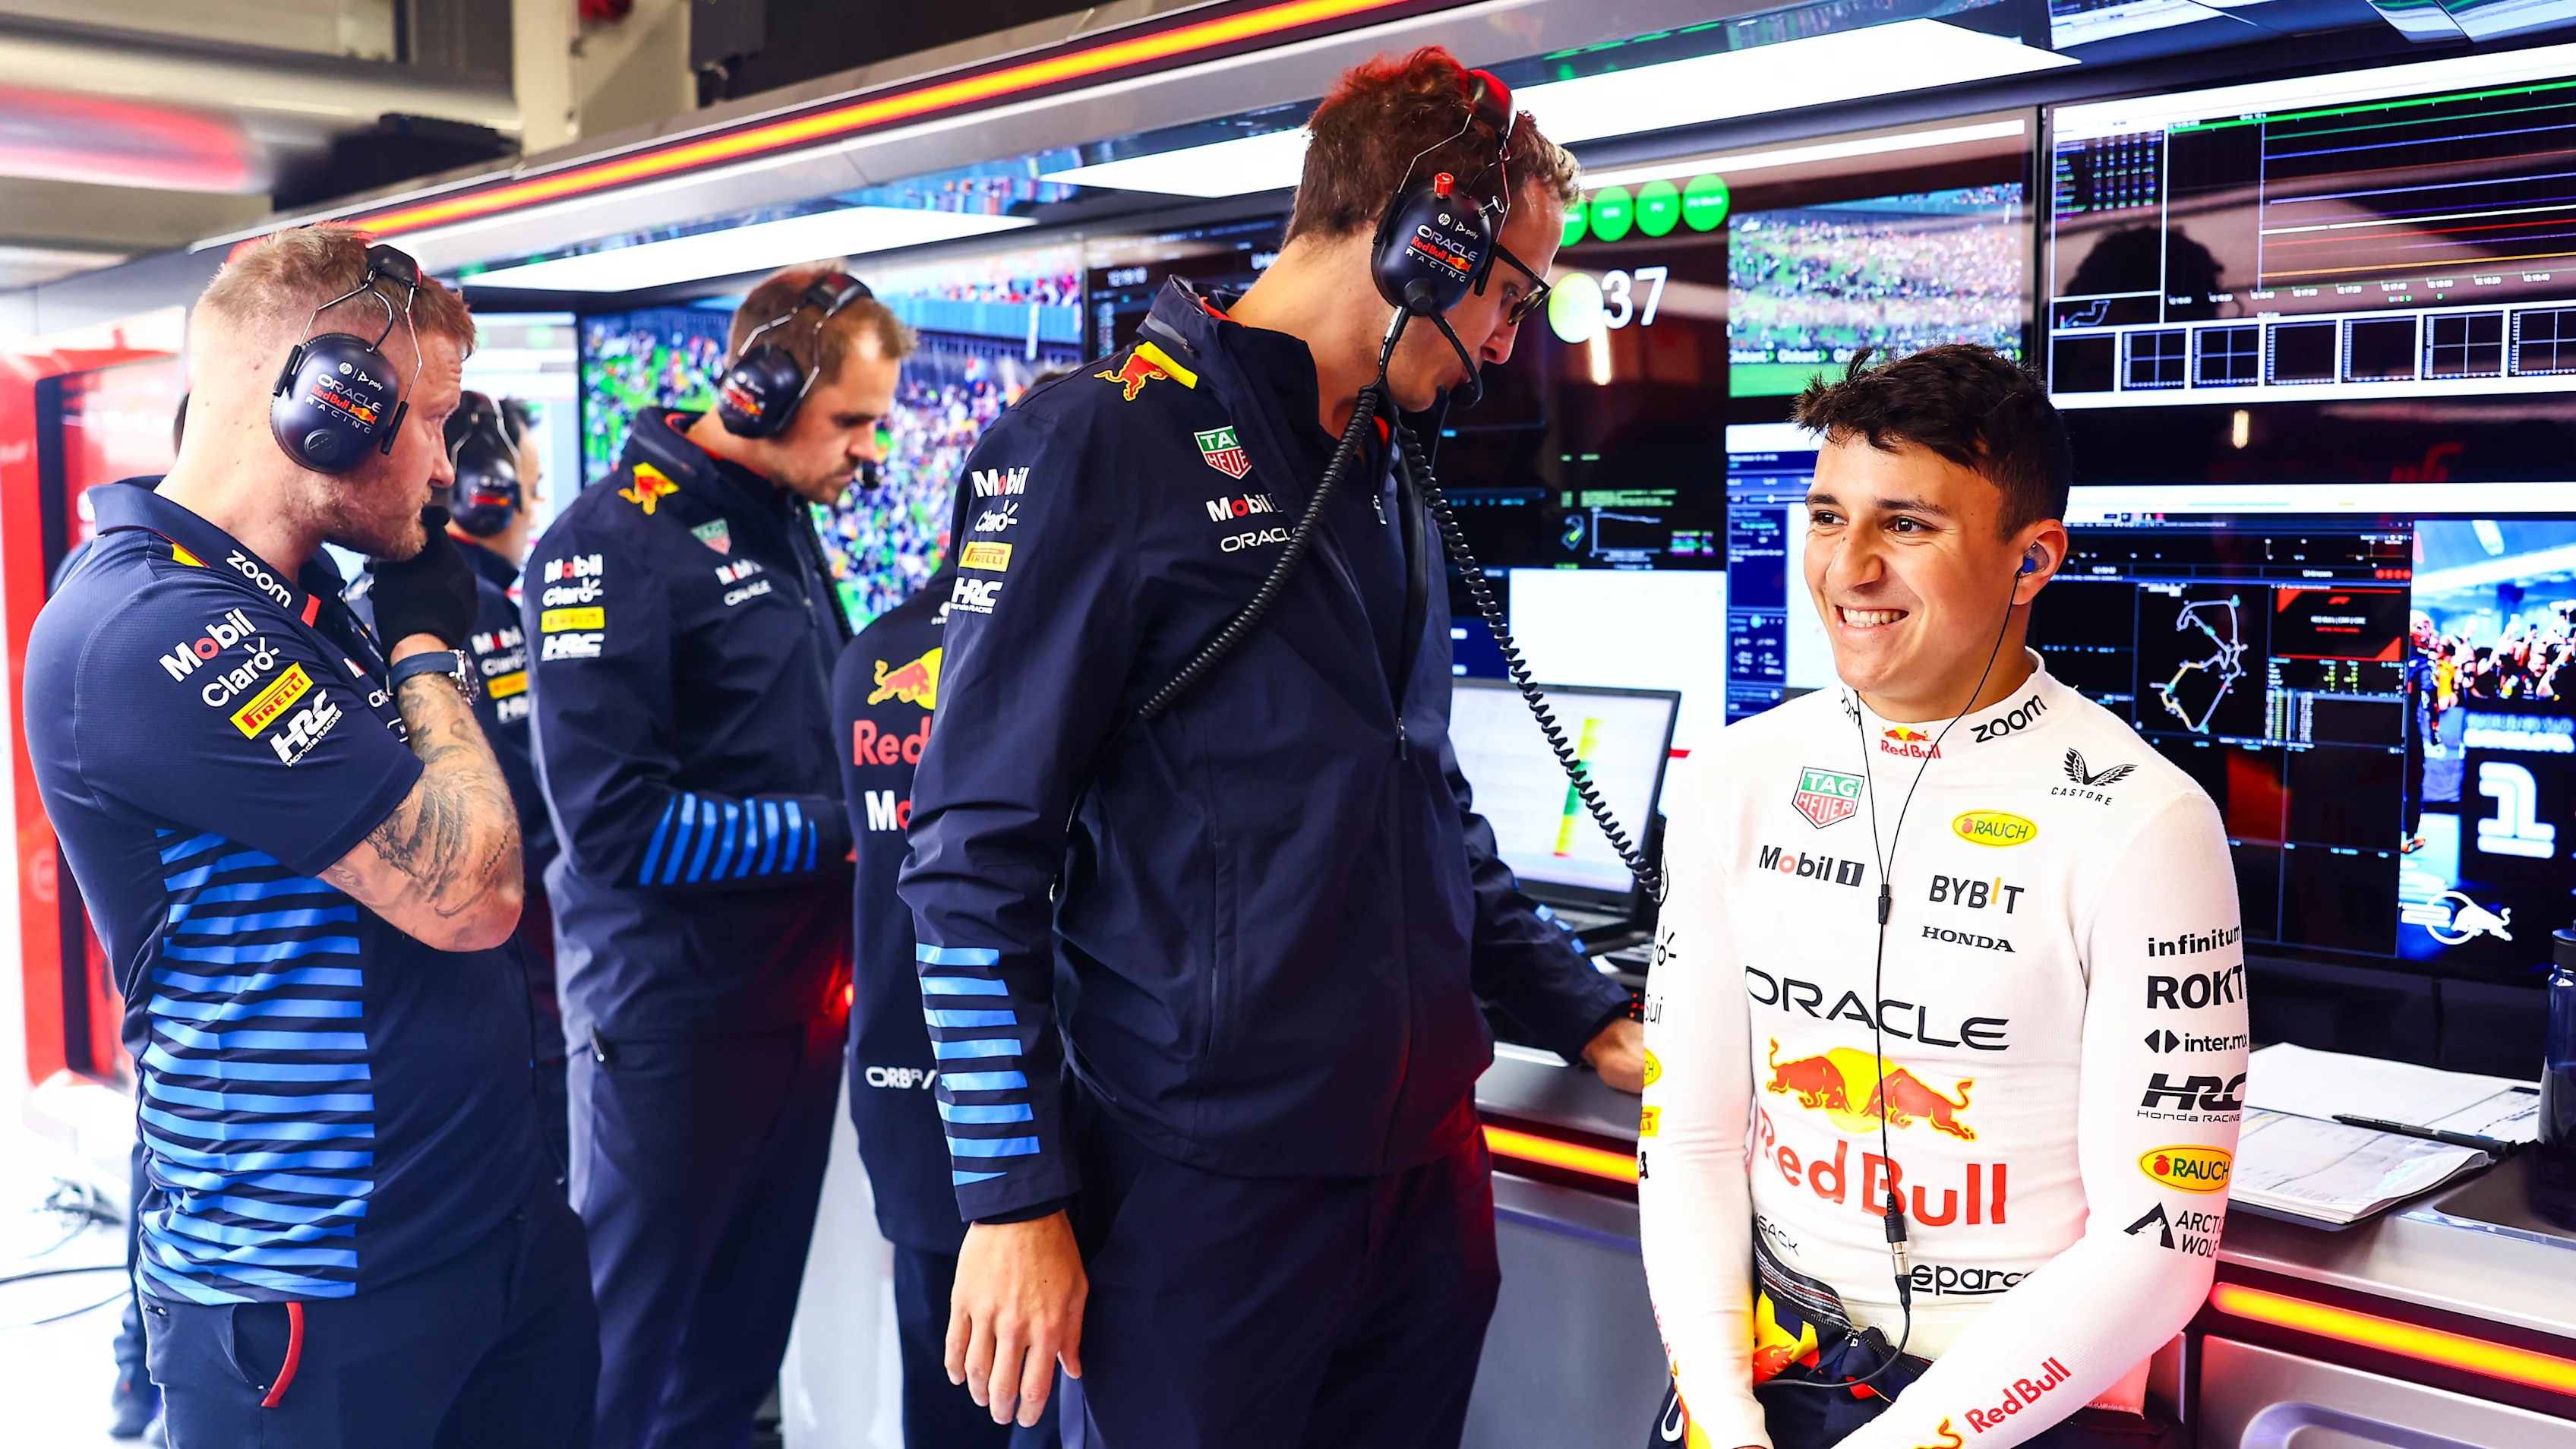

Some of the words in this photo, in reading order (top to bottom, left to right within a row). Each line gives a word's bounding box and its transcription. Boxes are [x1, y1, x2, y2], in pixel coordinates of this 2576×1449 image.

[1411, 235, 1429, 251] Red
[1428, 245, 1447, 260] Bull
[1417, 225, 1479, 262] ORACLE
[1465, 229, 1479, 240] poly
[1406, 248, 1466, 283] RACING
[1601, 266, 1668, 330] 37
[311, 384, 333, 402] Red
[329, 393, 351, 410] Bull
[317, 373, 383, 414] ORACLE
[368, 379, 384, 391] poly
[305, 396, 371, 434] RACING
[1200, 431, 1240, 451] TA
[1206, 450, 1249, 474] HEUE
[971, 466, 1031, 498] Mobil
[974, 503, 1015, 532] Claro
[1205, 494, 1274, 522] Mobil
[1220, 527, 1296, 553] ORACL
[544, 554, 603, 584] Mobil
[966, 547, 1005, 566] PIRELLI
[226, 549, 293, 608] zoom
[542, 579, 601, 608] Claro
[951, 576, 1004, 608] HRC
[158, 608, 257, 683] Mobil
[201, 642, 279, 709] Claro
[241, 671, 305, 730] PIRELLI
[270, 689, 338, 765] HRC
[1970, 694, 2047, 743] zoom
[285, 740, 319, 769] Honda
[316, 709, 343, 741] RACING
[852, 716, 932, 766] Red
[1880, 739, 1909, 757] Red
[1910, 744, 1942, 759] Bull
[1807, 773, 1857, 797] TAG
[2050, 787, 2113, 806] CASTORE
[1798, 794, 1855, 824] HEUER
[1975, 820, 2028, 839] RAUCH
[1759, 844, 1834, 882] Mobil
[1929, 875, 2025, 914] BYBIT
[1921, 926, 2016, 953] HONDA
[2148, 925, 2241, 957] infinitum
[2147, 963, 2243, 1009] ROKT
[1745, 965, 2010, 1051] ORACLE
[2184, 1033, 2248, 1053] inter.mx
[2141, 1072, 2246, 1111] HRC
[2137, 1110, 2199, 1122] Honda
[2202, 1113, 2240, 1122] RACING
[1759, 1105, 1848, 1204] Red
[1861, 1151, 2006, 1227] Bull
[2173, 1157, 2230, 1181] RAUCH
[2182, 1233, 2218, 1258] WOLF
[1911, 1264, 2035, 1296] sparc
[1965, 1387, 2023, 1434] Red
[2012, 1356, 2072, 1404] Bull
